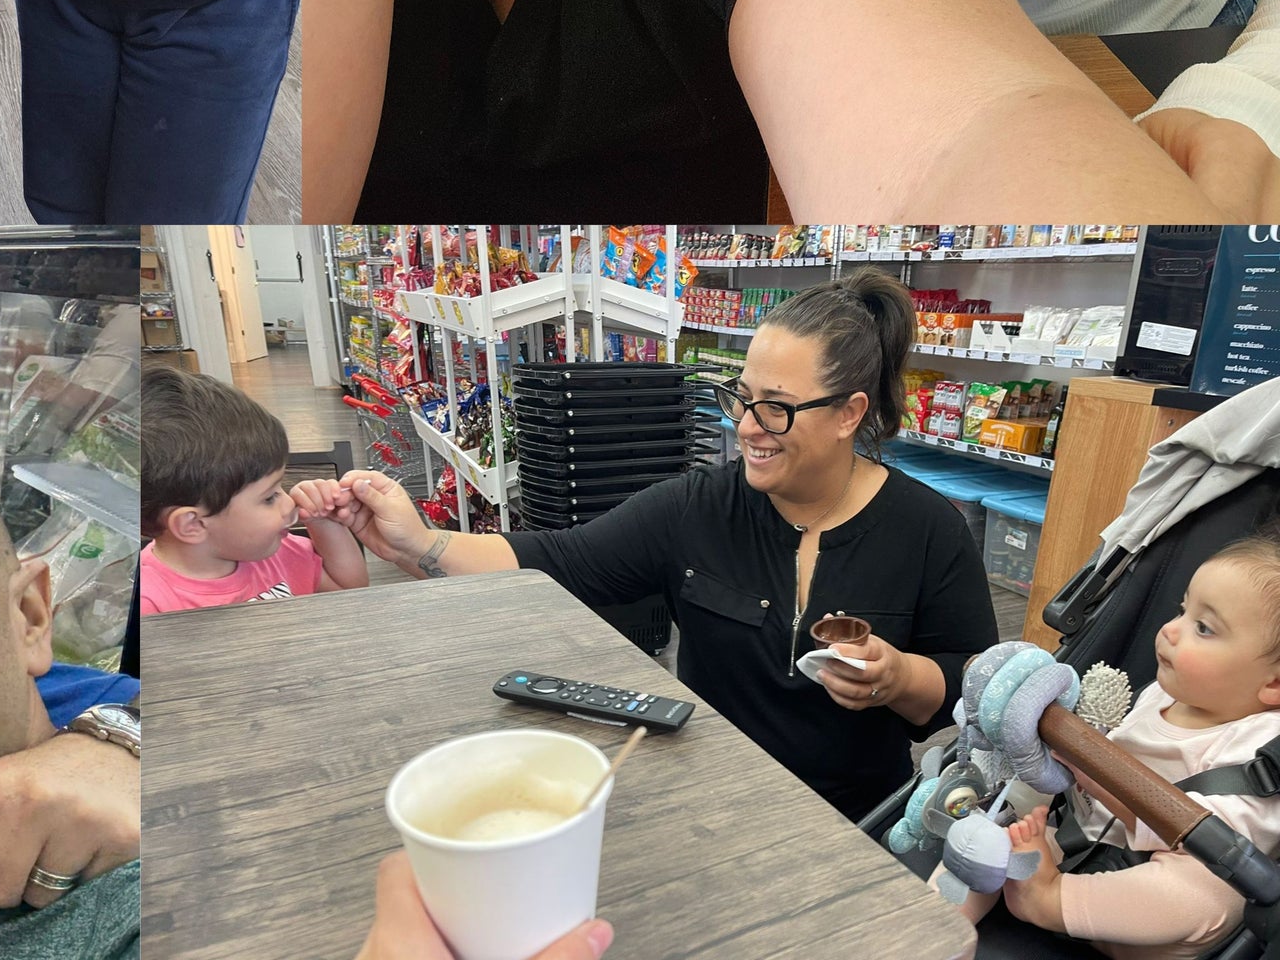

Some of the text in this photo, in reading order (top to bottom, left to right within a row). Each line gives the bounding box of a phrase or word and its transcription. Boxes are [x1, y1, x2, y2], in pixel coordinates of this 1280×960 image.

[1237, 303, 1260, 312] coffee
[1233, 322, 1272, 333] cappuccino
[1230, 341, 1265, 350] macchiato
